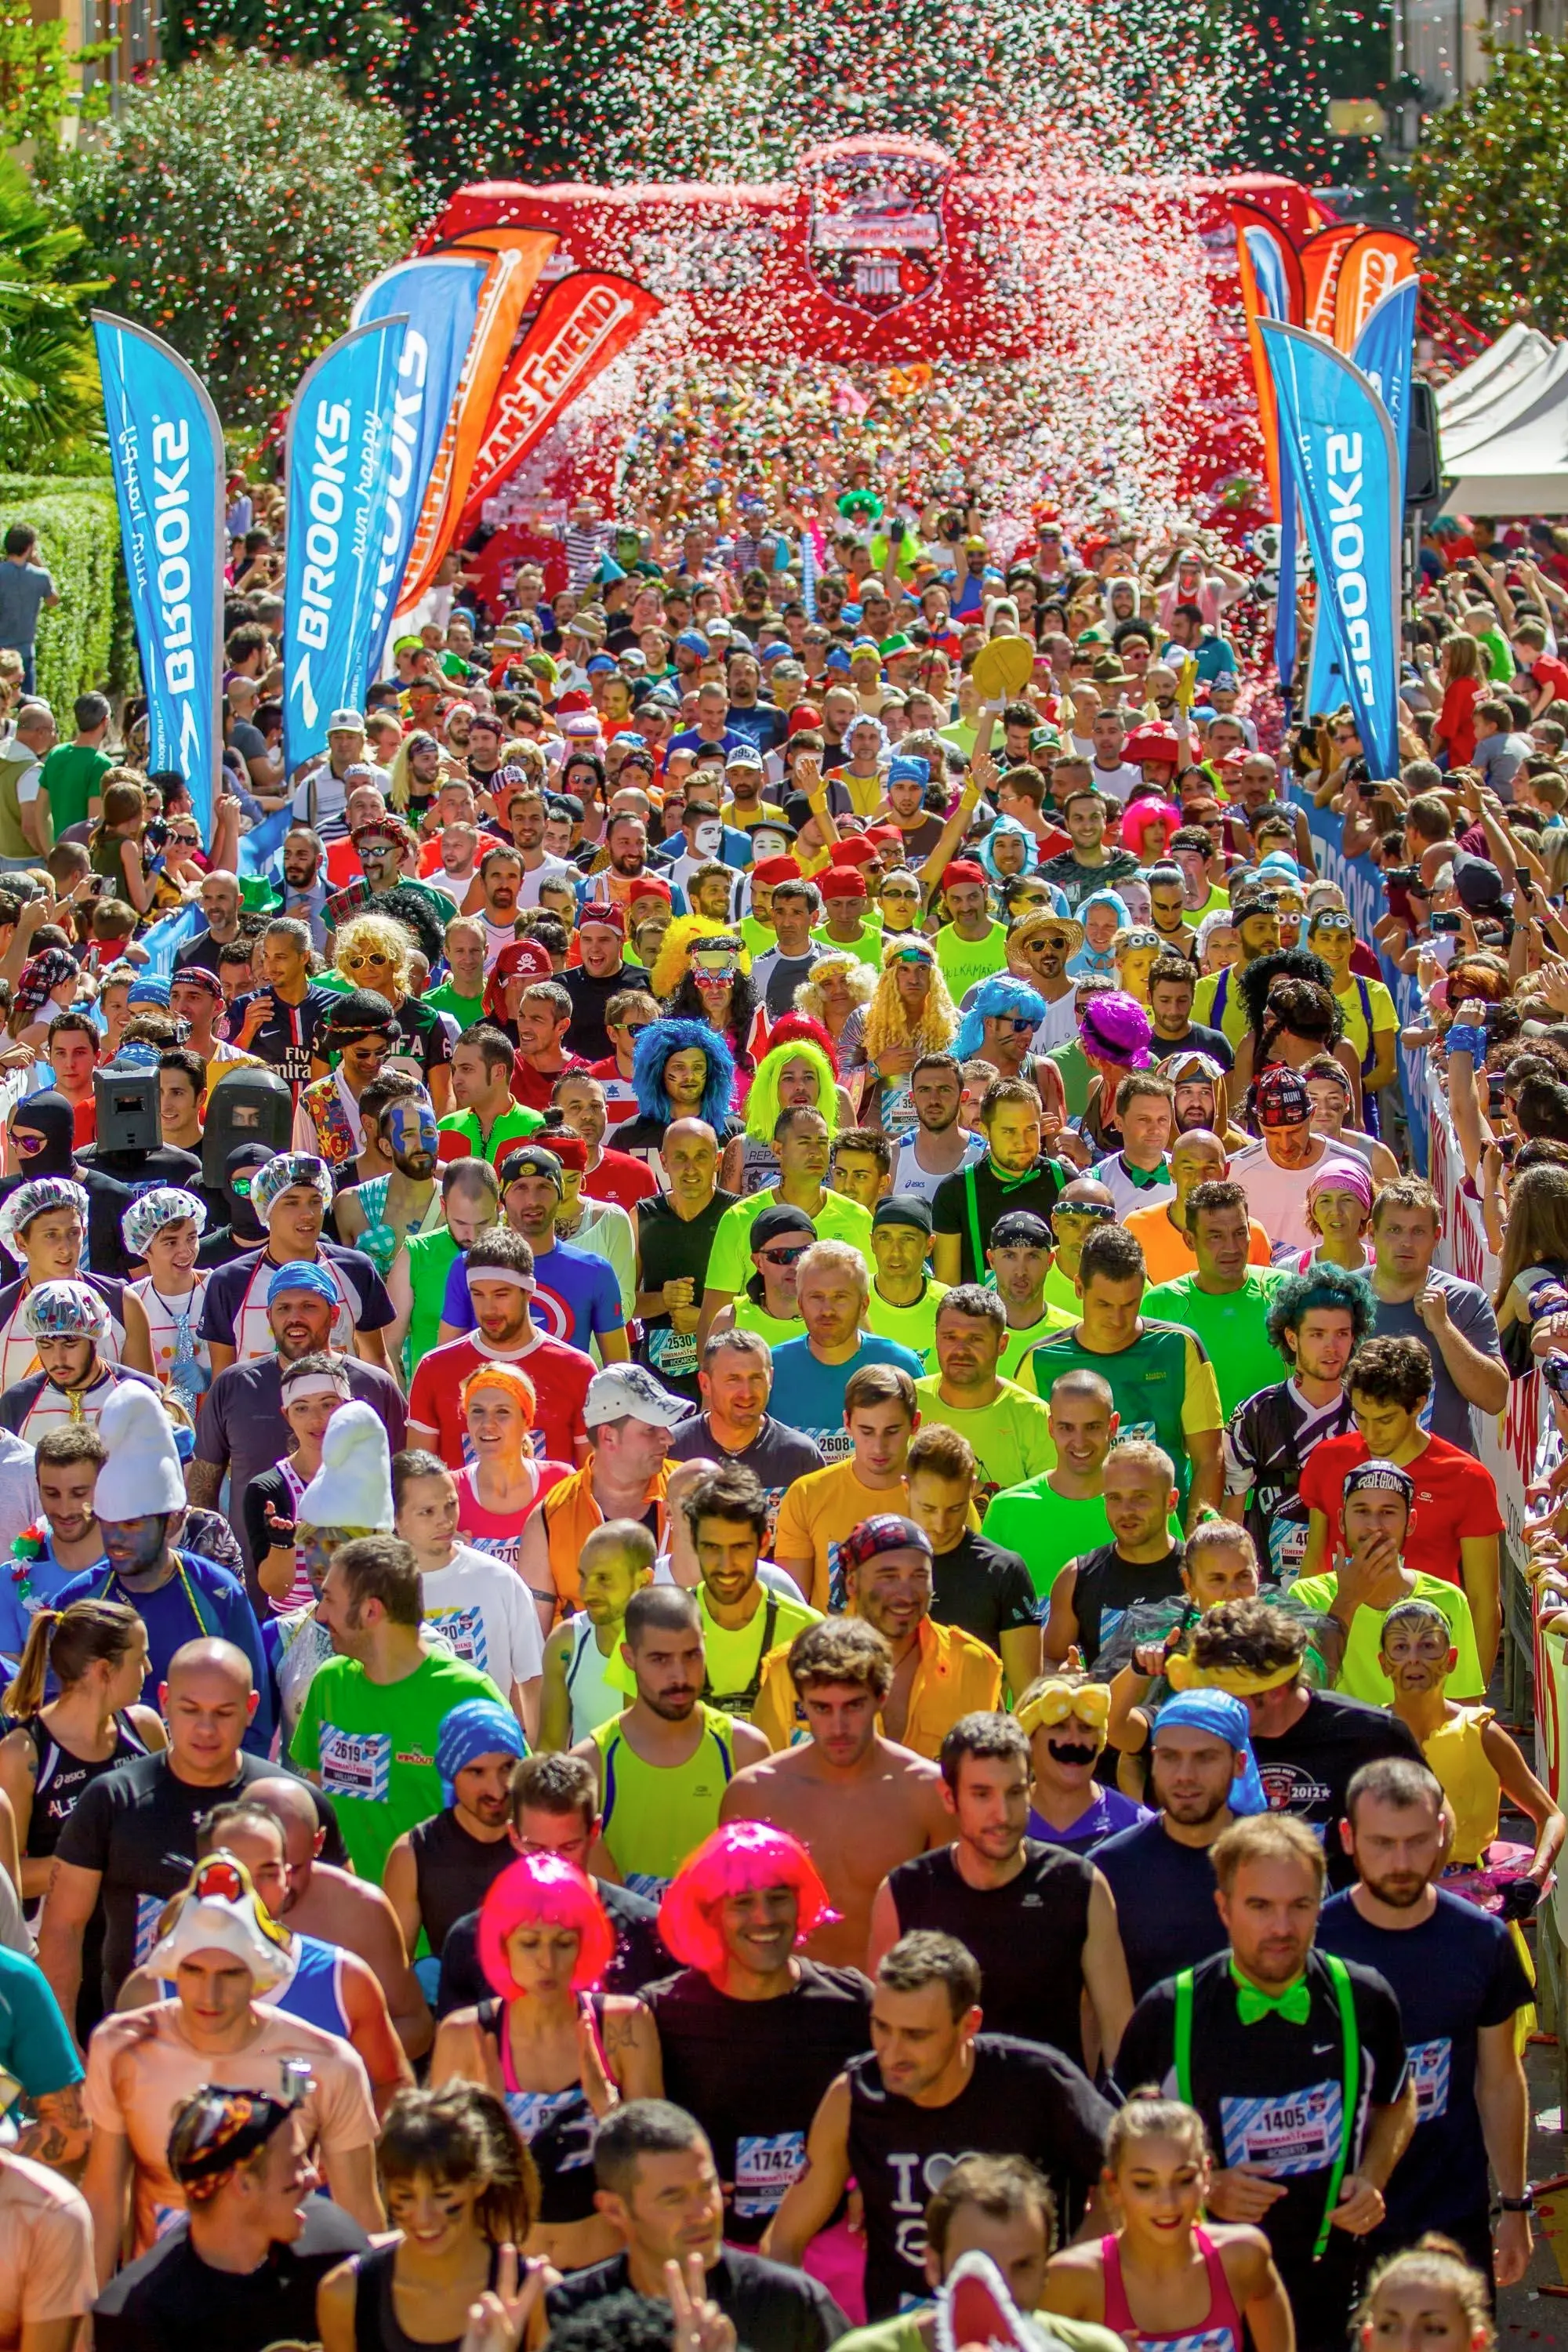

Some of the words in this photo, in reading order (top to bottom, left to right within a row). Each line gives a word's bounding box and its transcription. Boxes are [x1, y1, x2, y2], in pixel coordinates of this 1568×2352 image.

[516, 287, 620, 401] FRIEND
[354, 409, 383, 503] happy
[296, 399, 351, 651] BROOKS
[351, 508, 372, 559] run
[285, 1047, 310, 1061] Fly
[269, 1062, 312, 1079] mira
[902, 1098, 913, 1109] 35
[667, 1335, 692, 1349] 2530
[819, 1437, 850, 1451] 2608
[335, 1740, 361, 1762] 2619
[333, 1770, 359, 1784] WILLIAM
[1291, 1787, 1321, 1798] 2012
[1264, 2106, 1306, 2132] 1405
[753, 2150, 794, 2171] 1742
[887, 2153, 924, 2213] I
